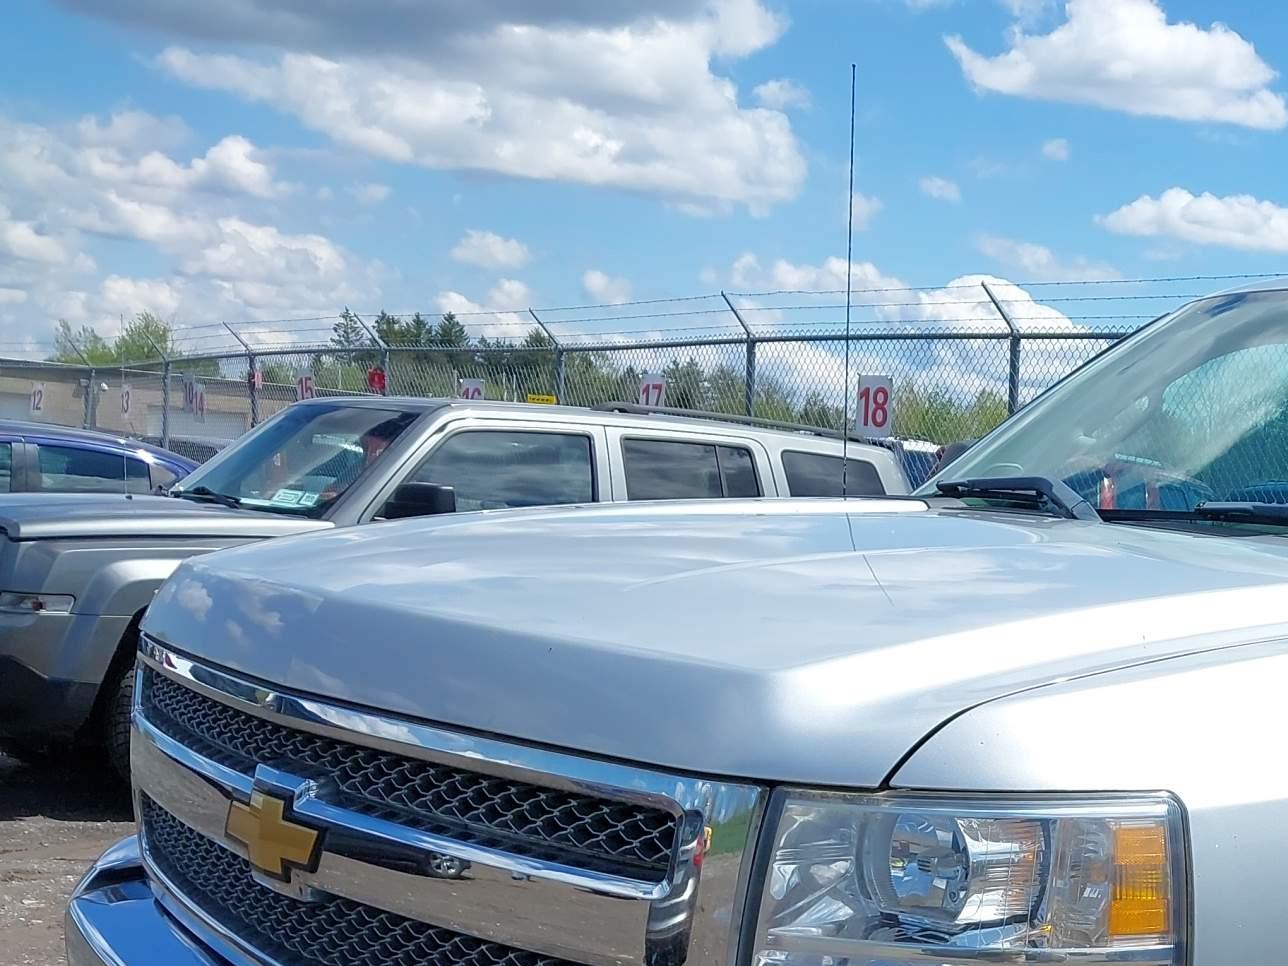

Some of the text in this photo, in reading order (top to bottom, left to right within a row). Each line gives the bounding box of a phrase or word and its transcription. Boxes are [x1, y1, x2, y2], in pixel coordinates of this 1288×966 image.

[297, 376, 314, 400] 15
[641, 383, 663, 407] 17
[32, 390, 43, 411] 12
[859, 386, 889, 428] 18
